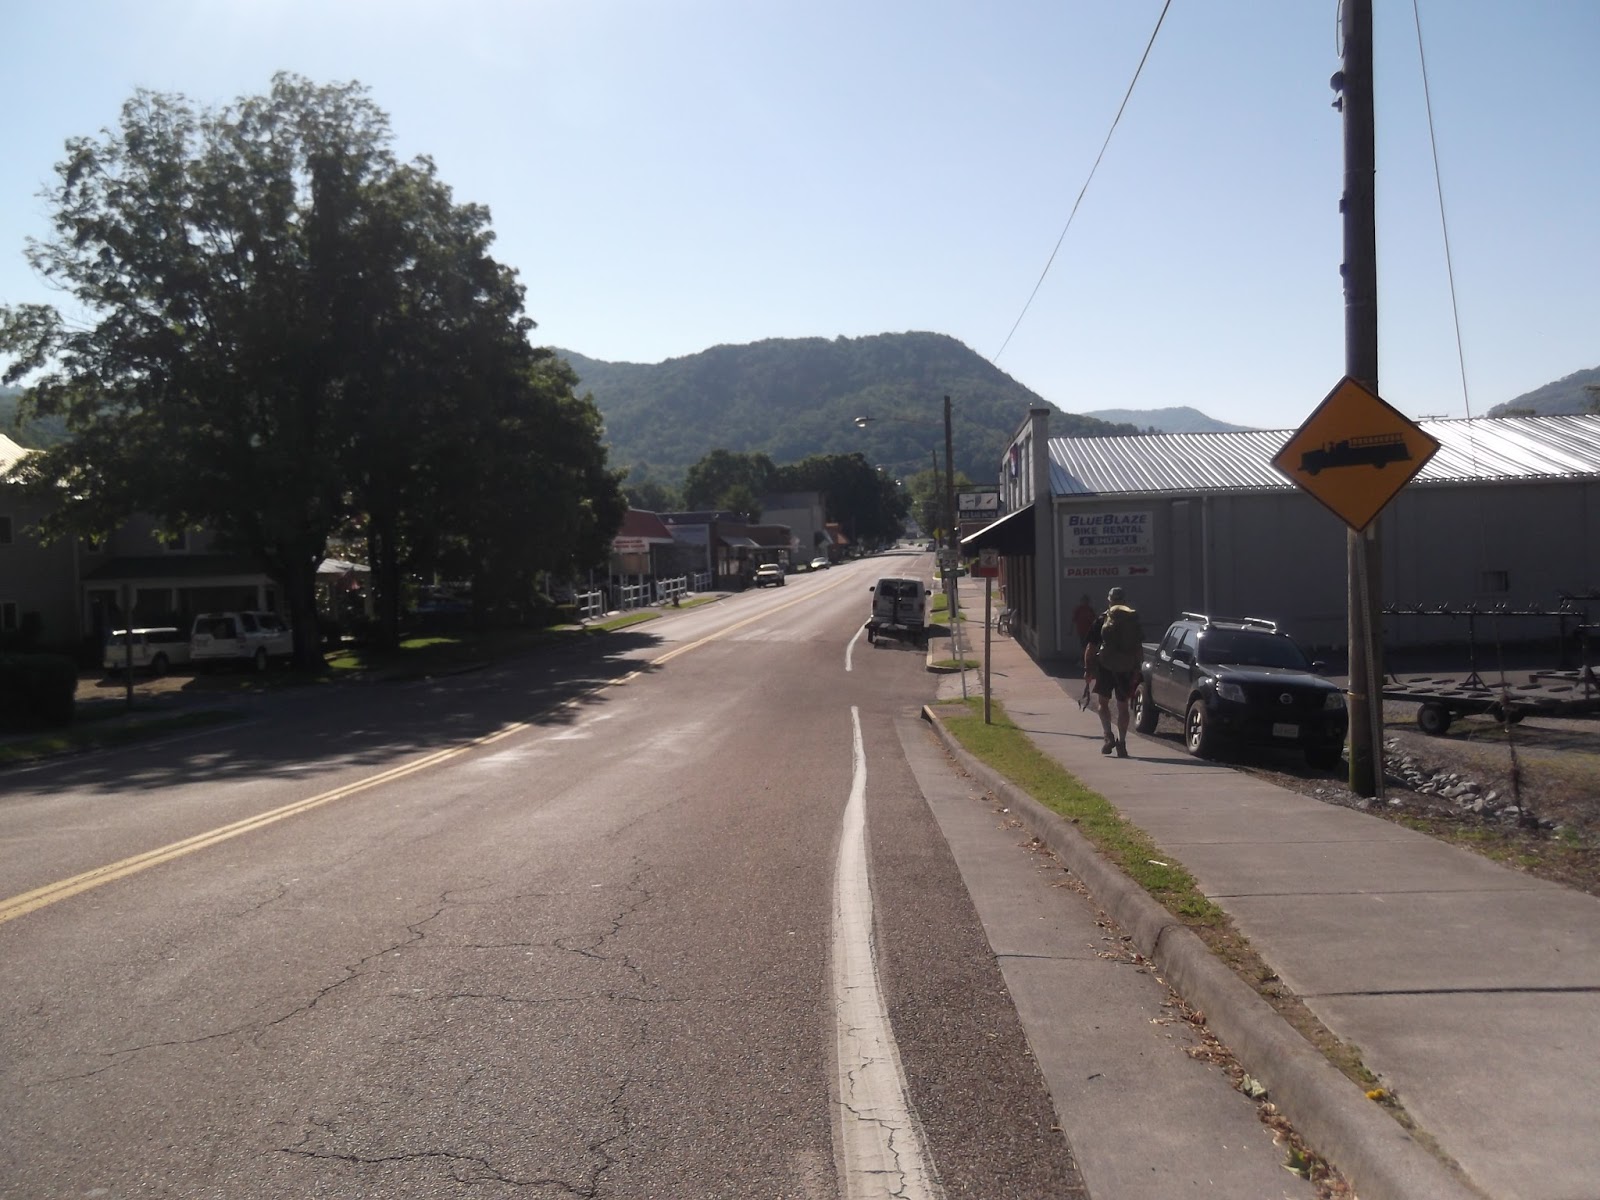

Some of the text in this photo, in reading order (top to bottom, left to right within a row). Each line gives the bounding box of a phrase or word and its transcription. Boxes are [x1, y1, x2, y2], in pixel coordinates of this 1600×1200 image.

[1073, 525, 1144, 536] BIKE RENTAL
[1093, 536, 1134, 545] SHUTTLE
[943, 559, 957, 567] 25
[1067, 567, 1119, 576] PARKING
